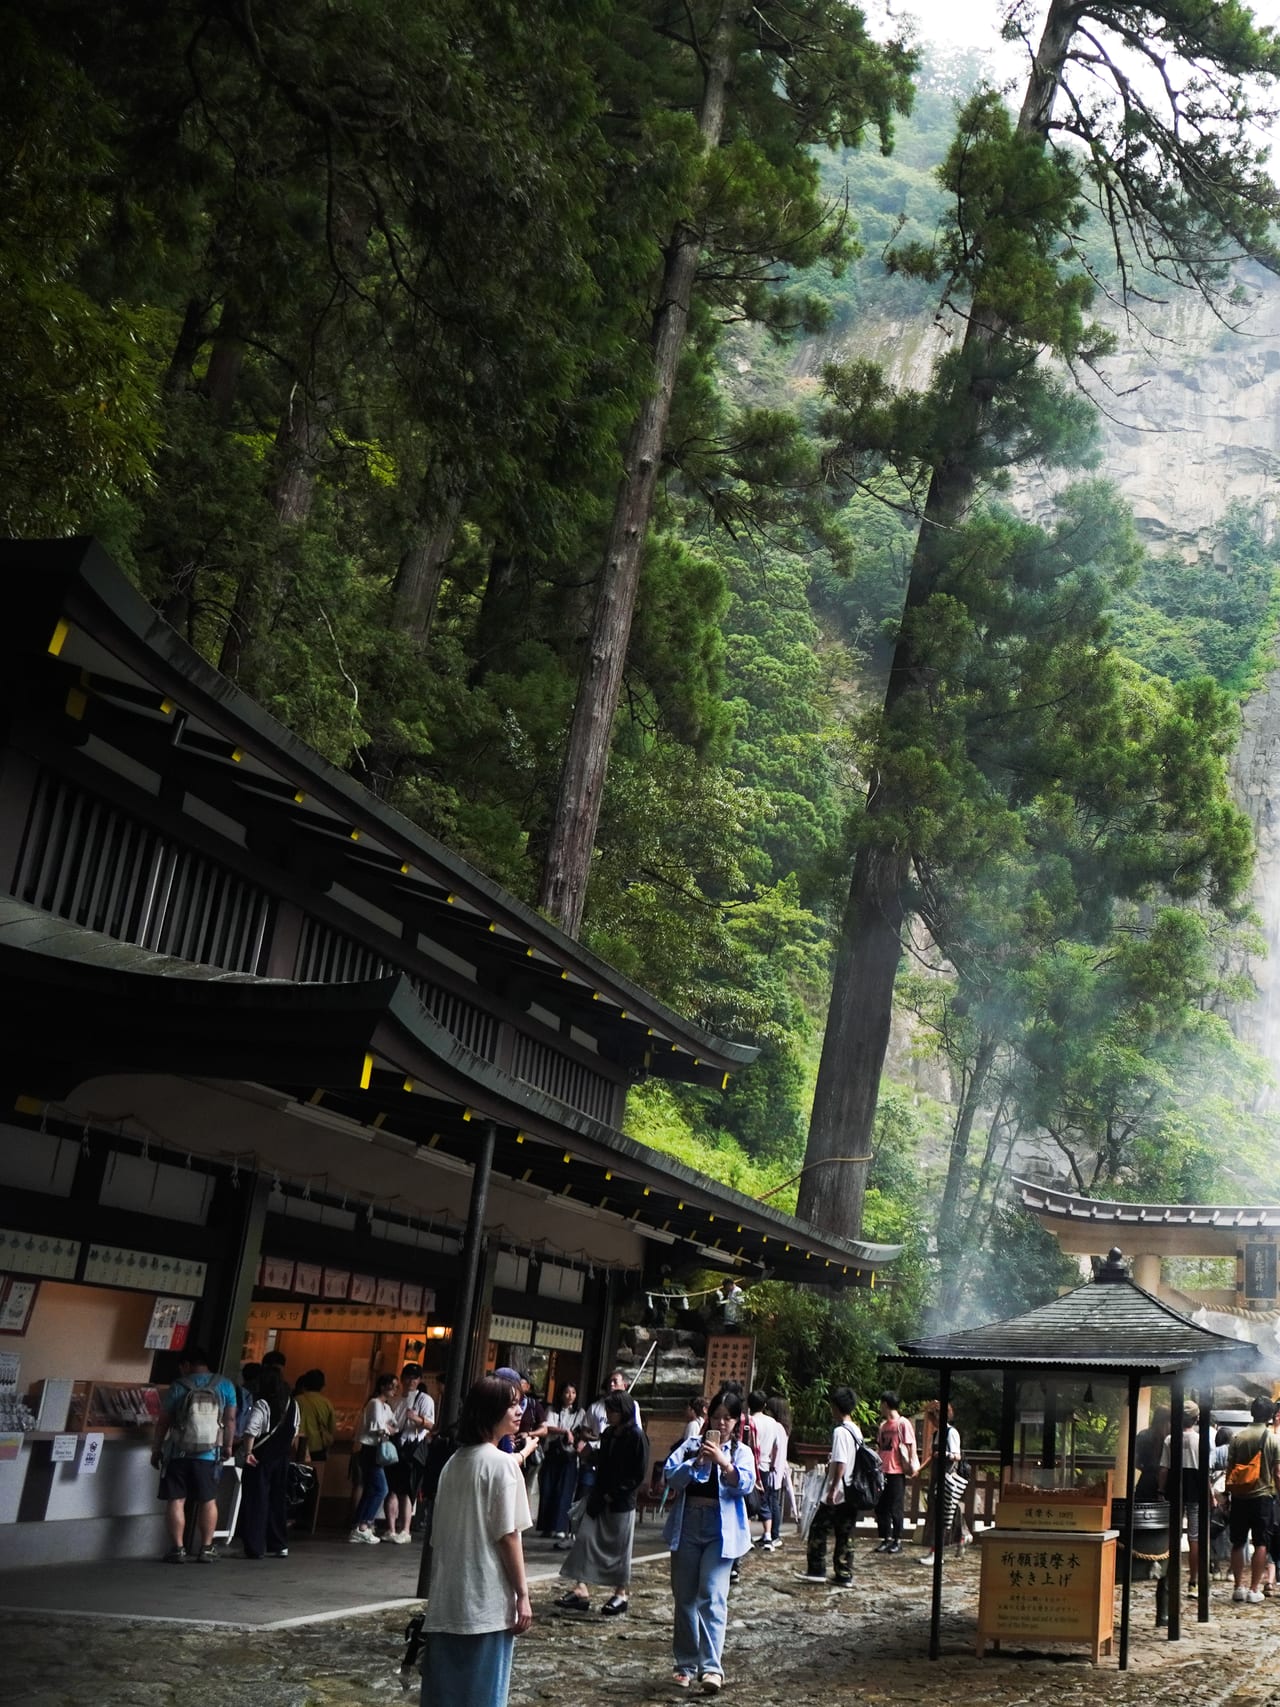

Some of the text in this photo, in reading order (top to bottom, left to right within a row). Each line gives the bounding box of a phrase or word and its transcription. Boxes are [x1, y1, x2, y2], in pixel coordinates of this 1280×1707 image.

[1001, 1552, 1081, 1570] 祈願護摩木
[1009, 1570, 1072, 1587] 焚き上げ
